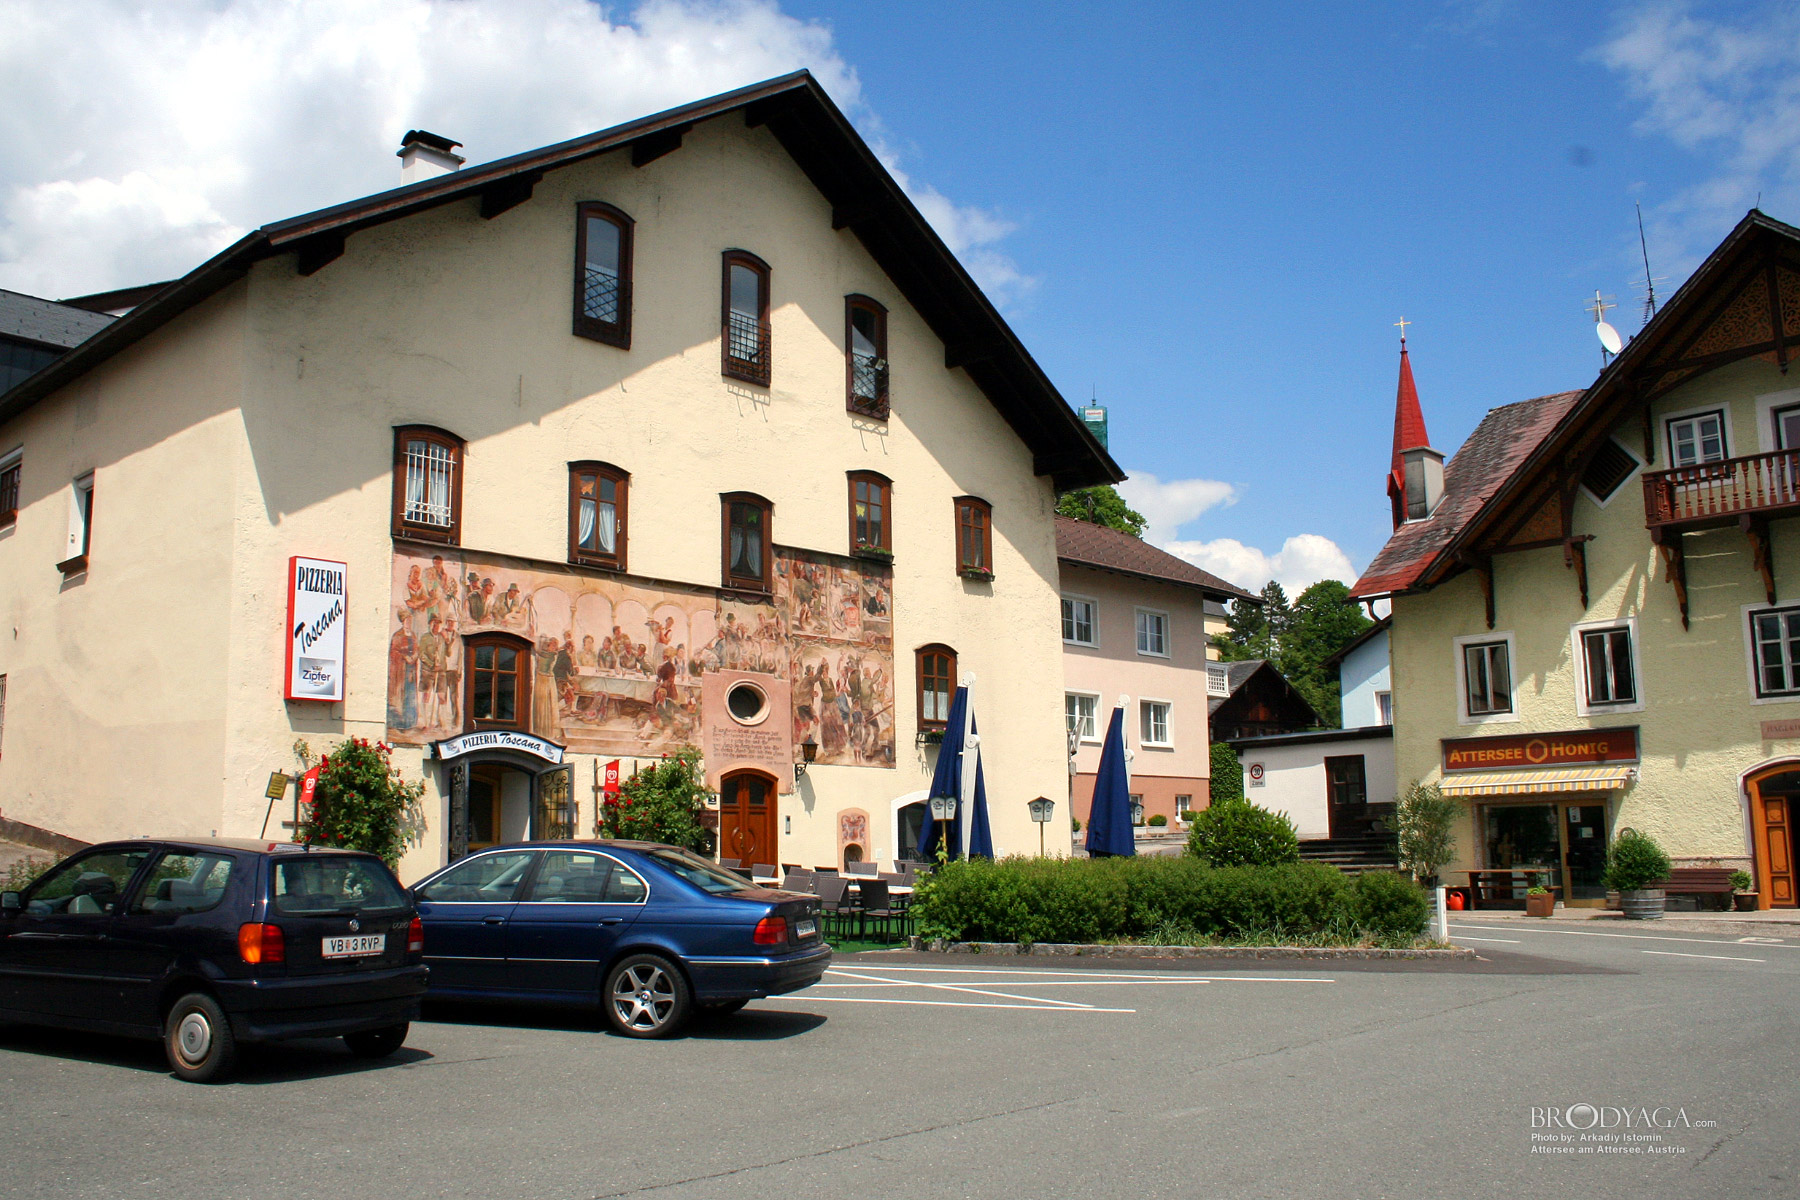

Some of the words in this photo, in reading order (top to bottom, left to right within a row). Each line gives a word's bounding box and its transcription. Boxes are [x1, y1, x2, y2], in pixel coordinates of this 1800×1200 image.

[298, 566, 343, 595] PIZZERIA
[294, 599, 343, 653] Toscana
[302, 669, 331, 682] Zipfer
[462, 735, 498, 749] PIZZERIA
[500, 733, 541, 751] Toscana
[1450, 748, 1522, 764] ATTERSEE
[1254, 767, 1261, 776] 30
[330, 940, 344, 953] VB
[352, 939, 358, 951] 3
[361, 937, 379, 950] RVP
